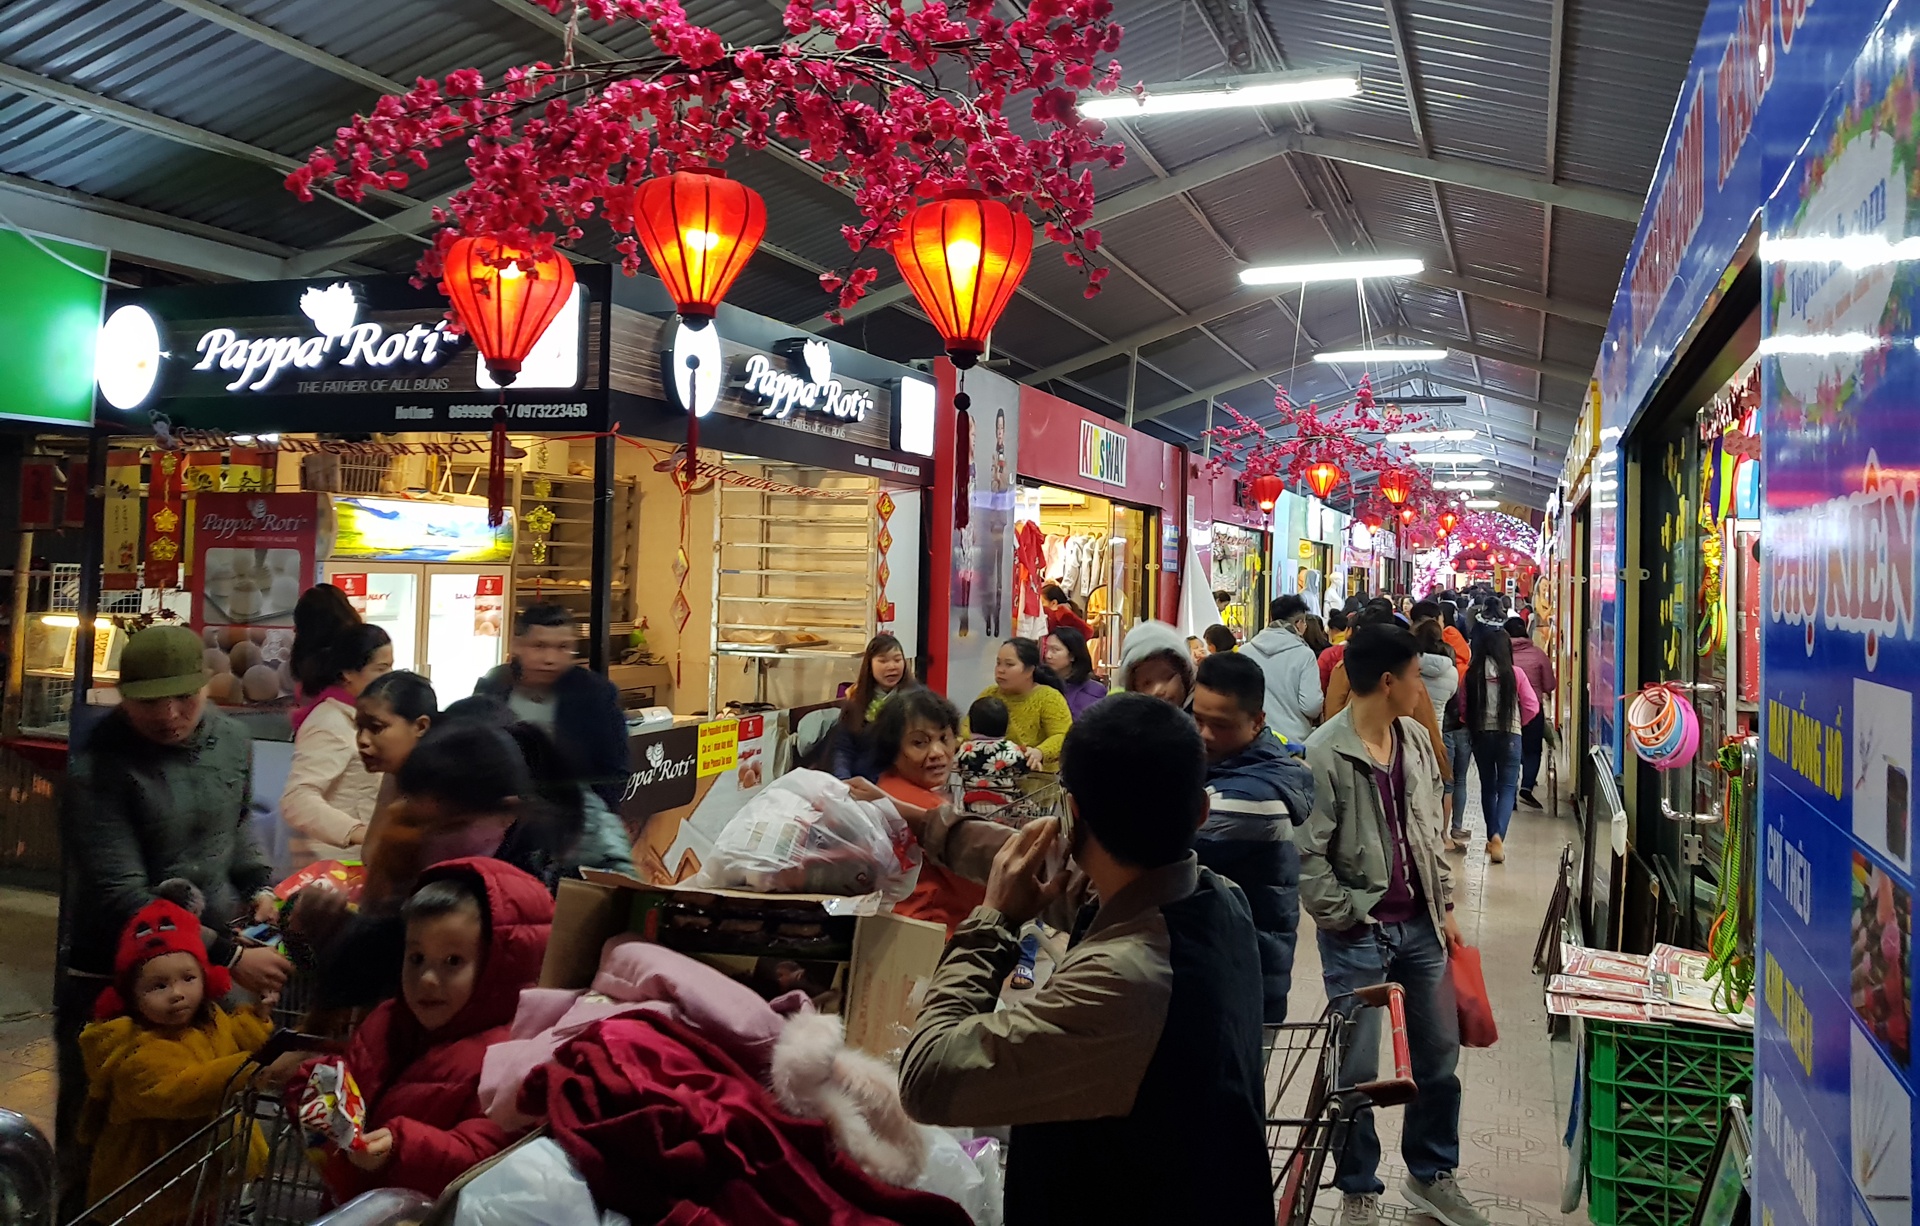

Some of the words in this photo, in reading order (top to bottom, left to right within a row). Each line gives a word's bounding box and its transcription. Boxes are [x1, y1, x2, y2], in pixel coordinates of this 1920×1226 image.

[192, 327, 330, 391] Pappa
[298, 381, 319, 393] THE
[322, 380, 367, 393] FATHER
[370, 379, 389, 391] OF
[389, 379, 412, 391] ALL
[414, 377, 450, 391] BUNS
[744, 354, 818, 418] Pappa
[517, 403, 588, 418] 0973223458
[202, 513, 256, 539] Pappa
[1785, 839, 1811, 926] THÊU
[1785, 978, 1813, 1077] THÊU
